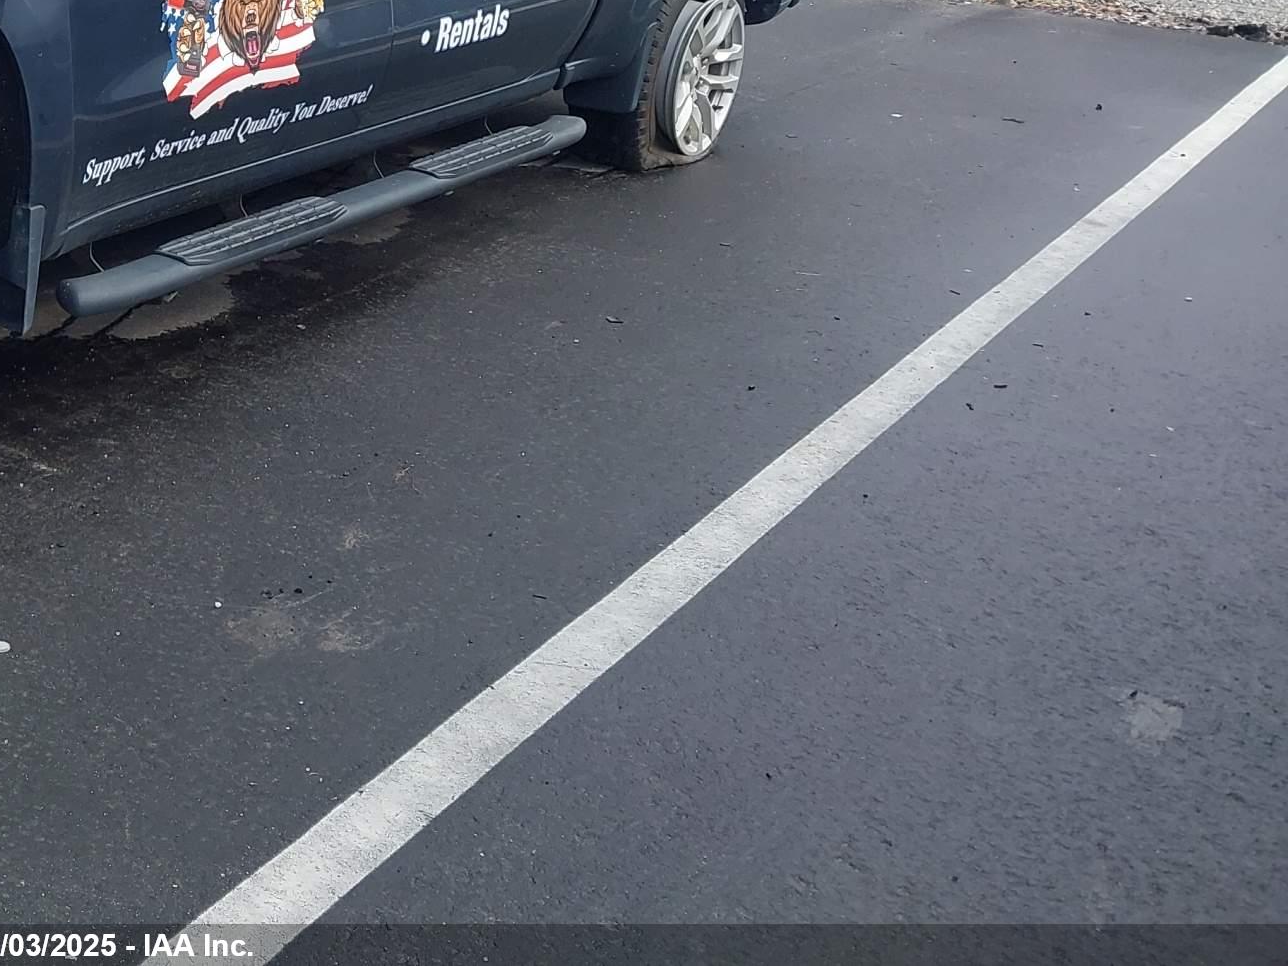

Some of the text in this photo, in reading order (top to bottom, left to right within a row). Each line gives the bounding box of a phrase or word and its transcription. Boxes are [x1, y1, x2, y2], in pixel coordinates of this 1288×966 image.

[434, 4, 510, 53] Rentals
[82, 84, 373, 187] Support, Service and Quality You Deserve!
